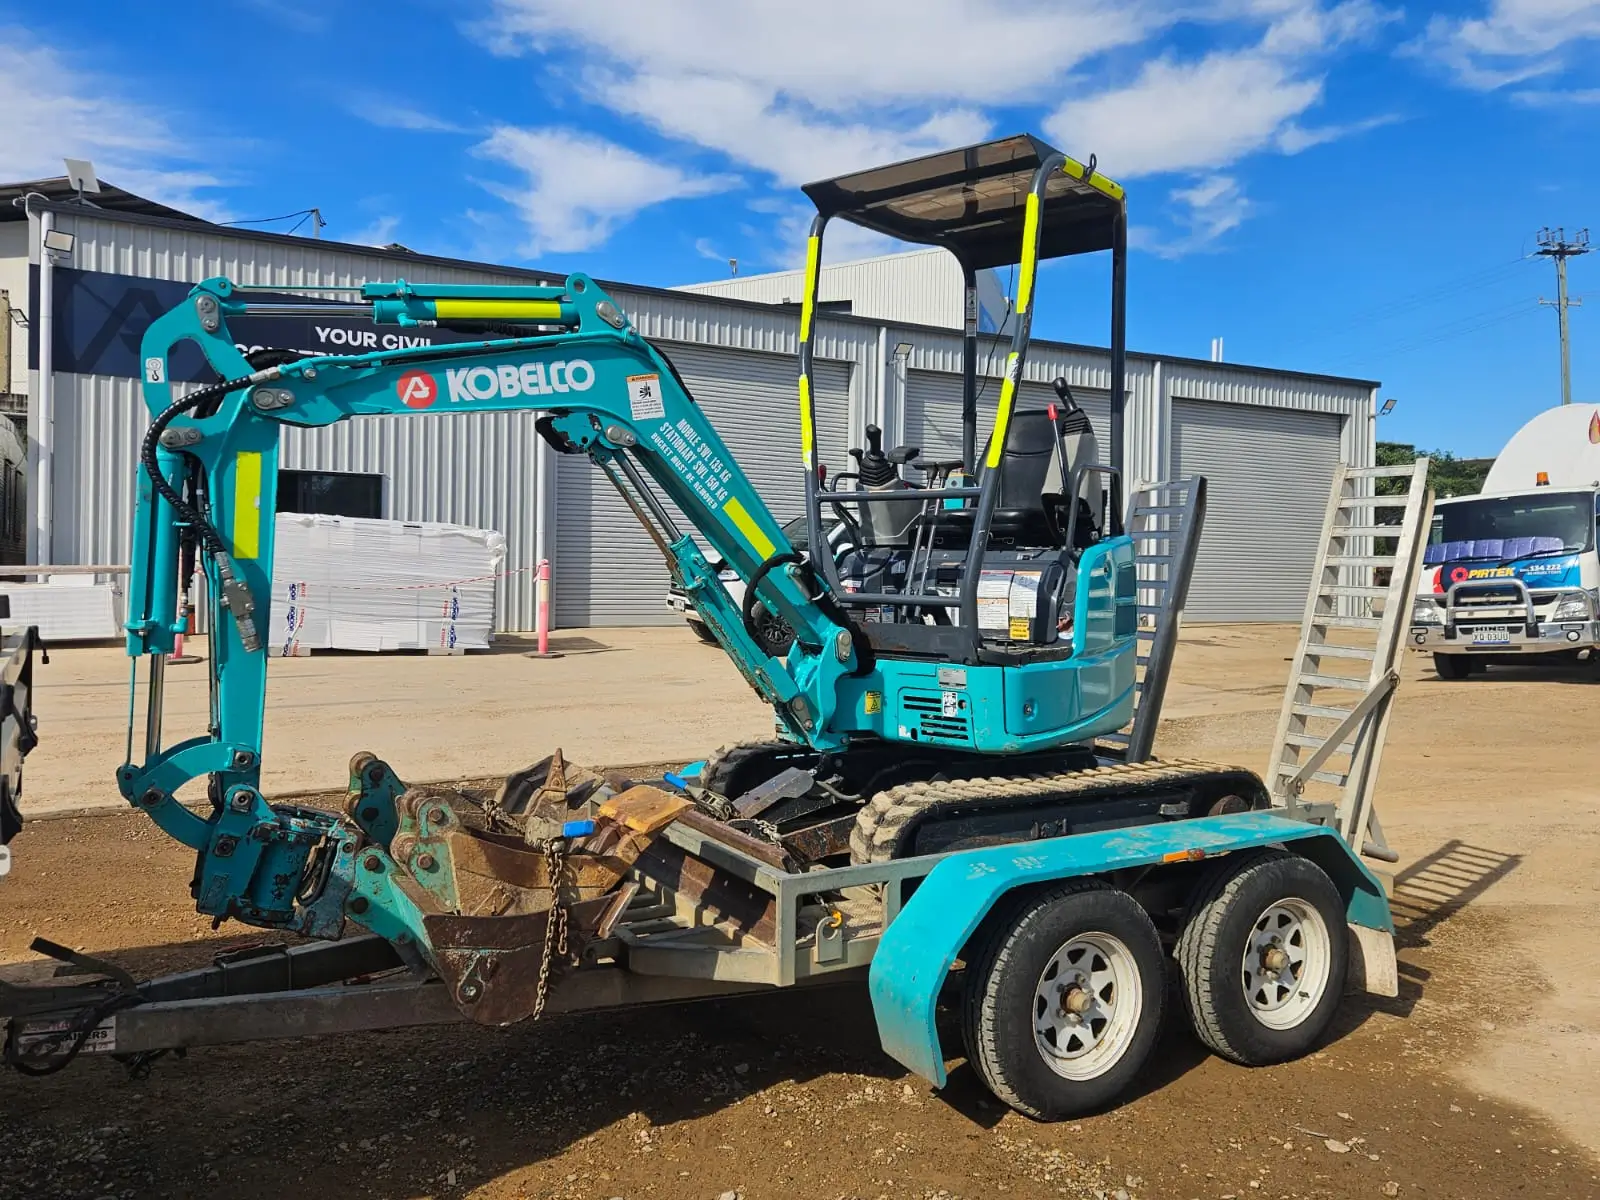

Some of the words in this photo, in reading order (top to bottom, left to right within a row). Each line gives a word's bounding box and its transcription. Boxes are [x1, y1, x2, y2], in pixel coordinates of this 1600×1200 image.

[315, 326, 377, 348] YOUR
[446, 359, 595, 402] KOBELCO
[651, 432, 673, 457] BUCKET
[671, 455, 688, 474] MUST
[686, 472, 695, 483] BE
[693, 480, 718, 510] REMOVED
[660, 422, 697, 464] STATIONARY
[693, 461, 709, 479] SWL
[705, 475, 720, 491] 150
[715, 487, 728, 502] KG
[676, 418, 701, 447] MOBILE
[697, 443, 713, 461] SWL
[709, 457, 724, 474] 135
[720, 469, 732, 484] KG
[1468, 566, 1516, 579] PIRTEK
